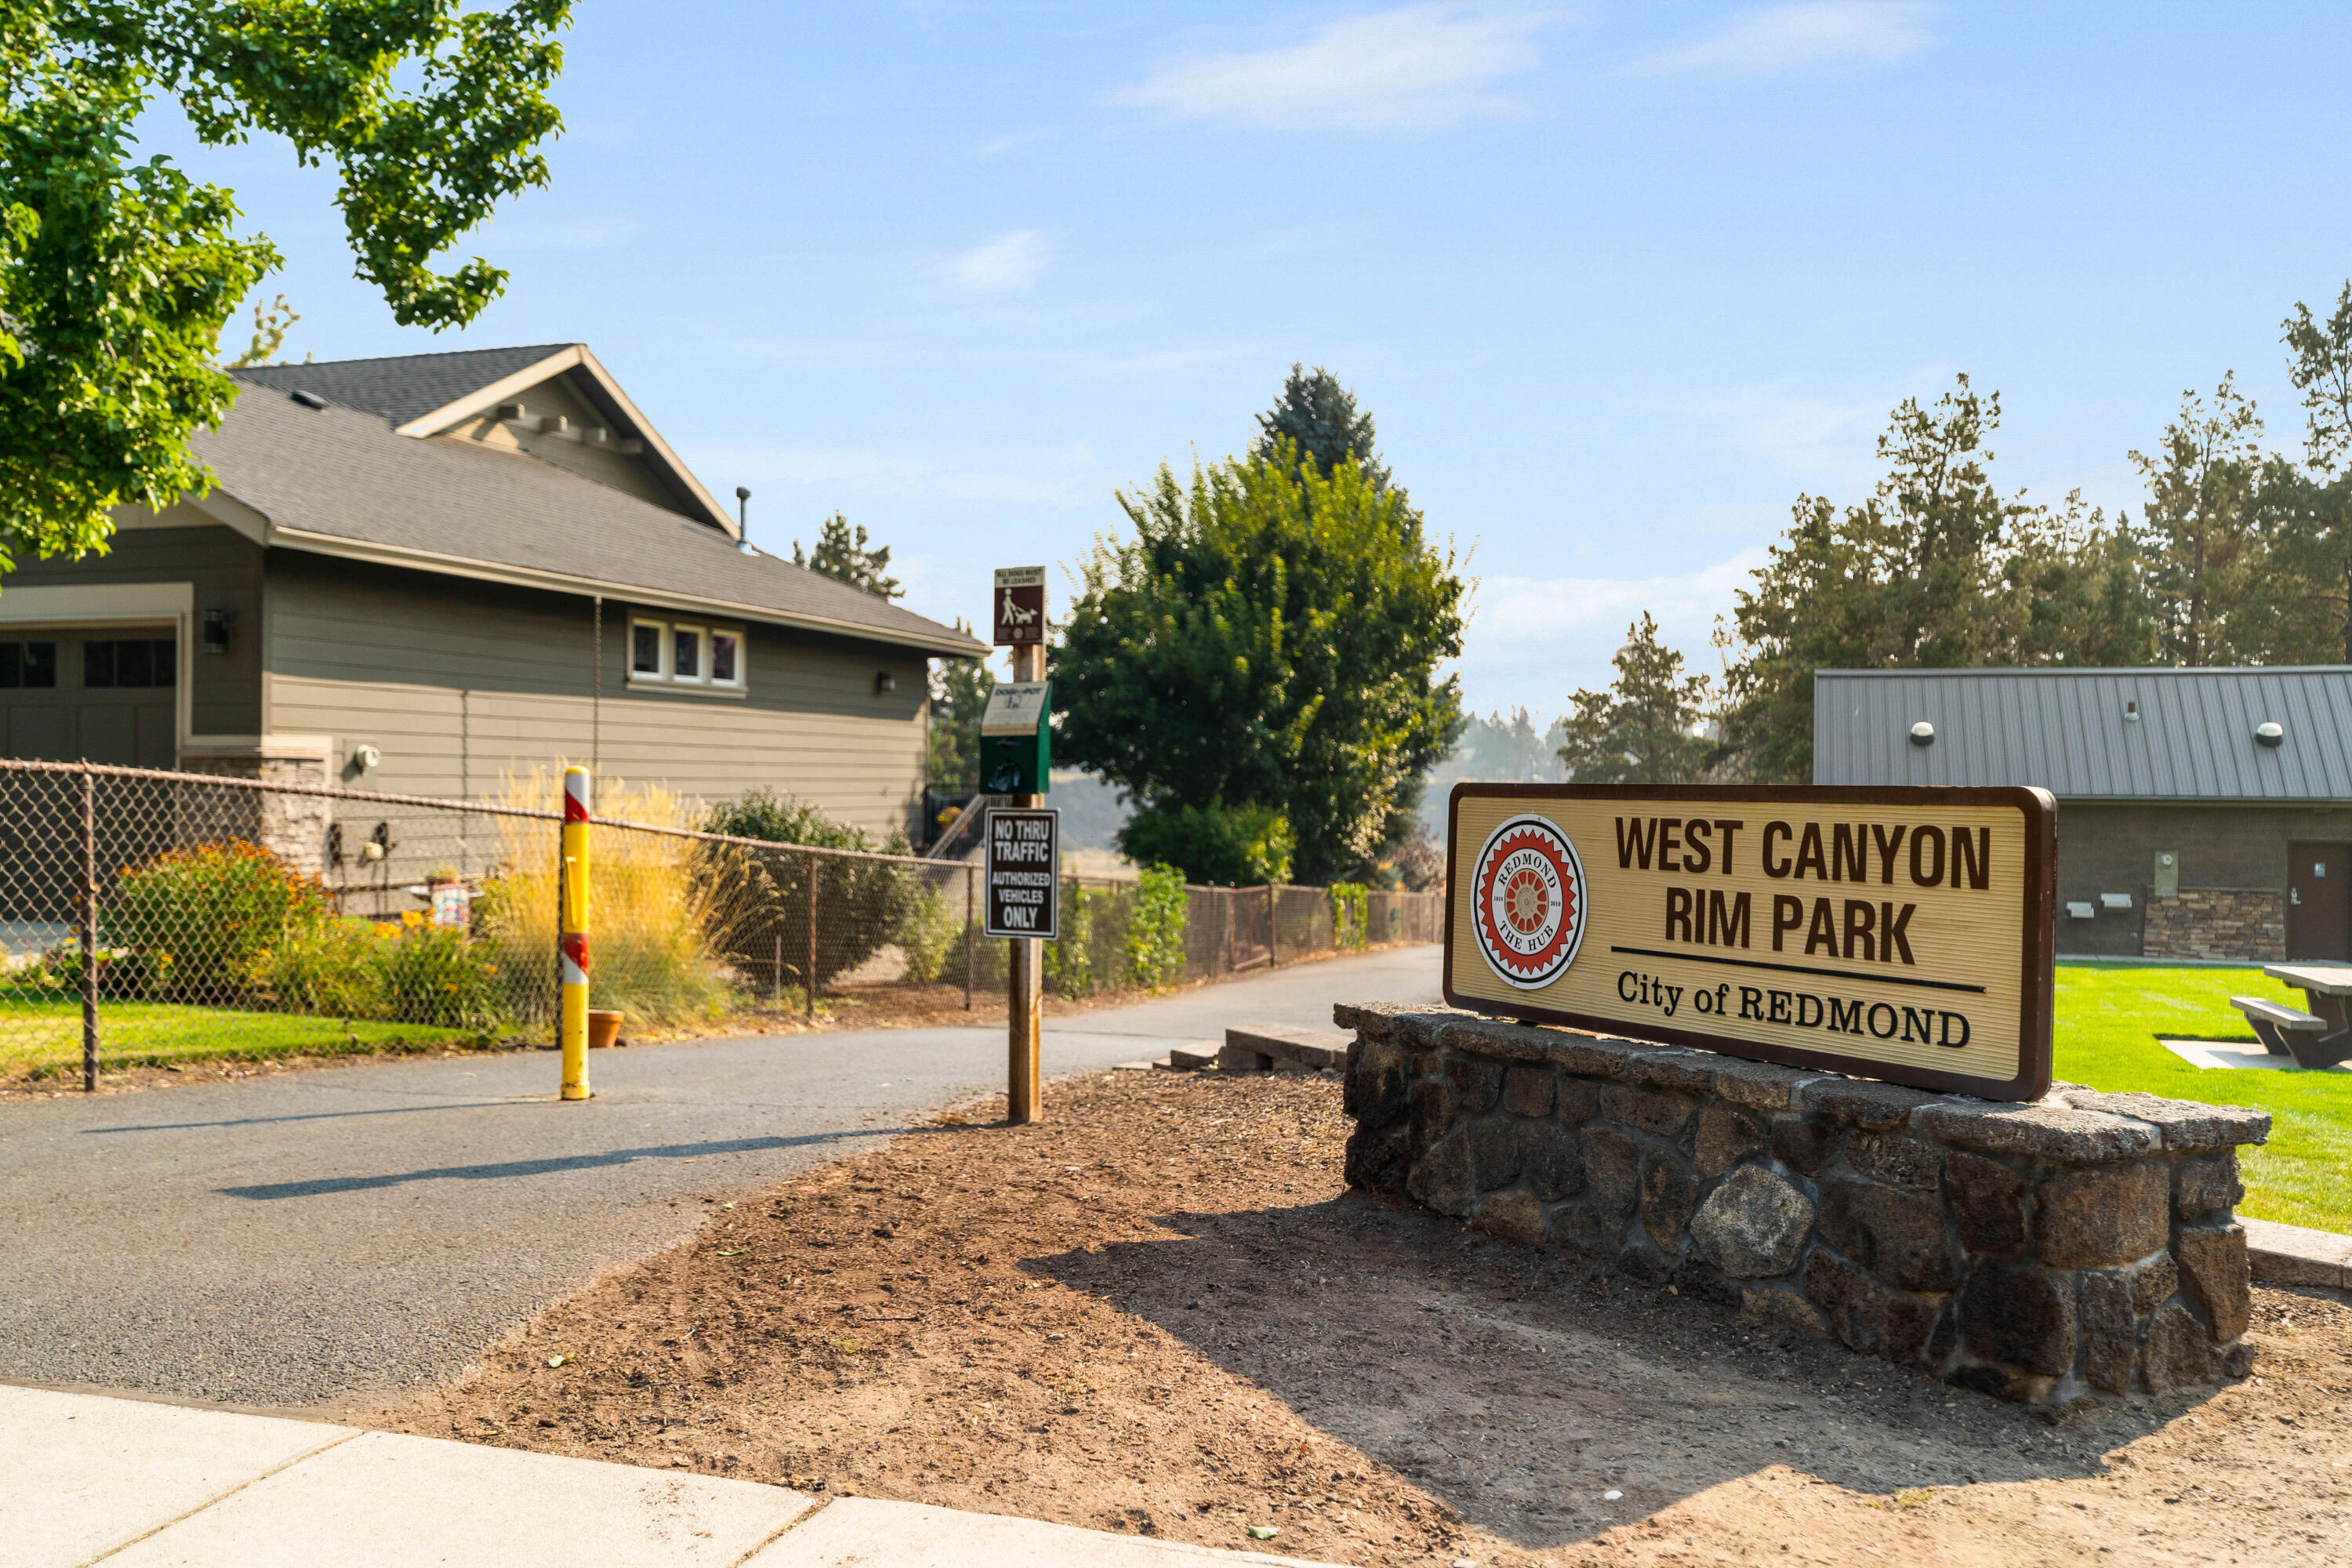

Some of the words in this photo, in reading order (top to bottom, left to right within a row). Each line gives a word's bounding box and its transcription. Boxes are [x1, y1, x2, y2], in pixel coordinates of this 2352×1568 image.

[994, 819, 1014, 840] NO
[1015, 819, 1050, 840] THRU
[994, 841, 1049, 862] TRAFFIC
[1615, 816, 1744, 875] WEST
[1762, 820, 1991, 890] CANYON
[992, 871, 1051, 887] AUTHORIZED
[1498, 853, 1556, 888] REDMOND
[998, 888, 1044, 904] VEHICLES
[1003, 906, 1038, 928] ONLY
[1665, 887, 1751, 949] RIM
[1772, 894, 1917, 965] PARK
[1499, 920, 1523, 950] THE
[1529, 924, 1554, 951] HUB
[1617, 971, 1684, 1017] City
[1694, 983, 1730, 1015] of
[1738, 986, 1971, 1048] REDMOND
